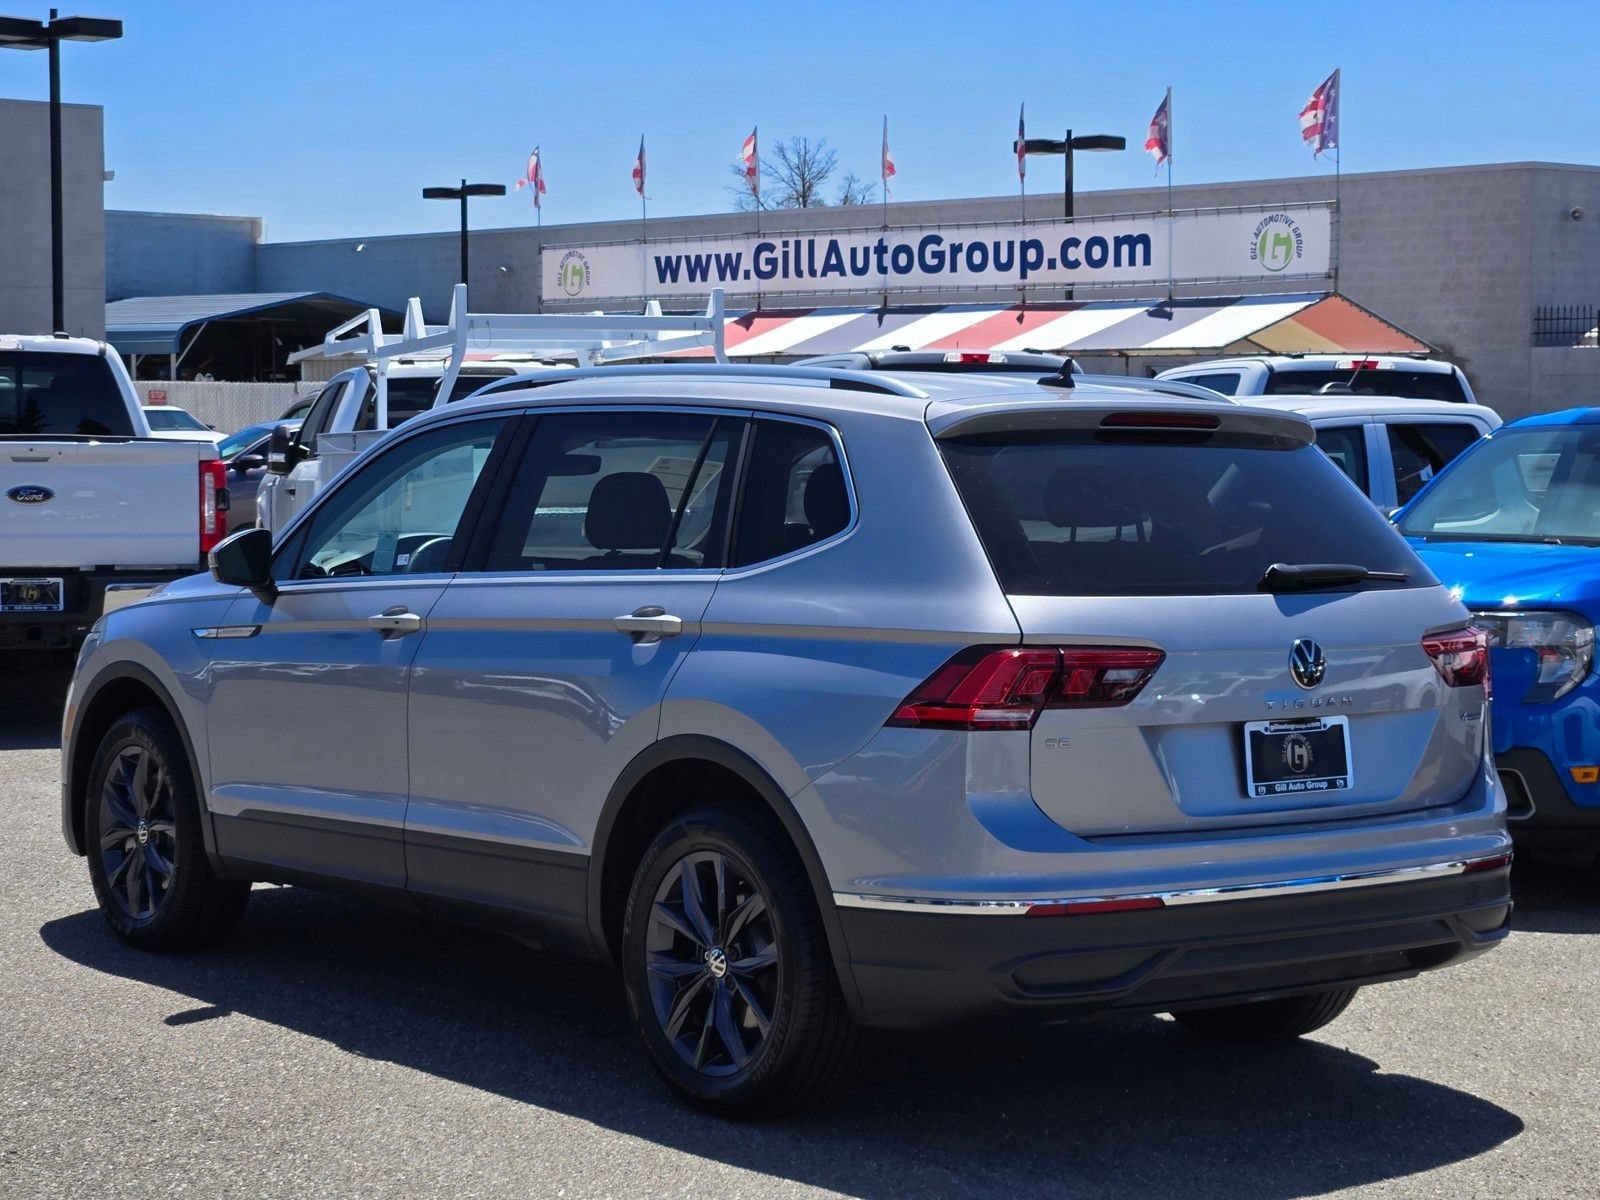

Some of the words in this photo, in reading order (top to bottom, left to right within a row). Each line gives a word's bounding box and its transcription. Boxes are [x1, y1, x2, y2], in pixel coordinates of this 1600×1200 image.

[1254, 214, 1295, 240] AUTOMOTIVE
[1292, 226, 1303, 259] GROUP
[654, 233, 1151, 284] www.GillAutoGroup.com
[17, 490, 44, 501] Ford
[1265, 696, 1353, 710] TIGUAN
[1045, 737, 1072, 751] SE
[1275, 784, 1287, 792] Gill
[1288, 782, 1305, 791] Auto
[1306, 780, 1328, 790] Group
